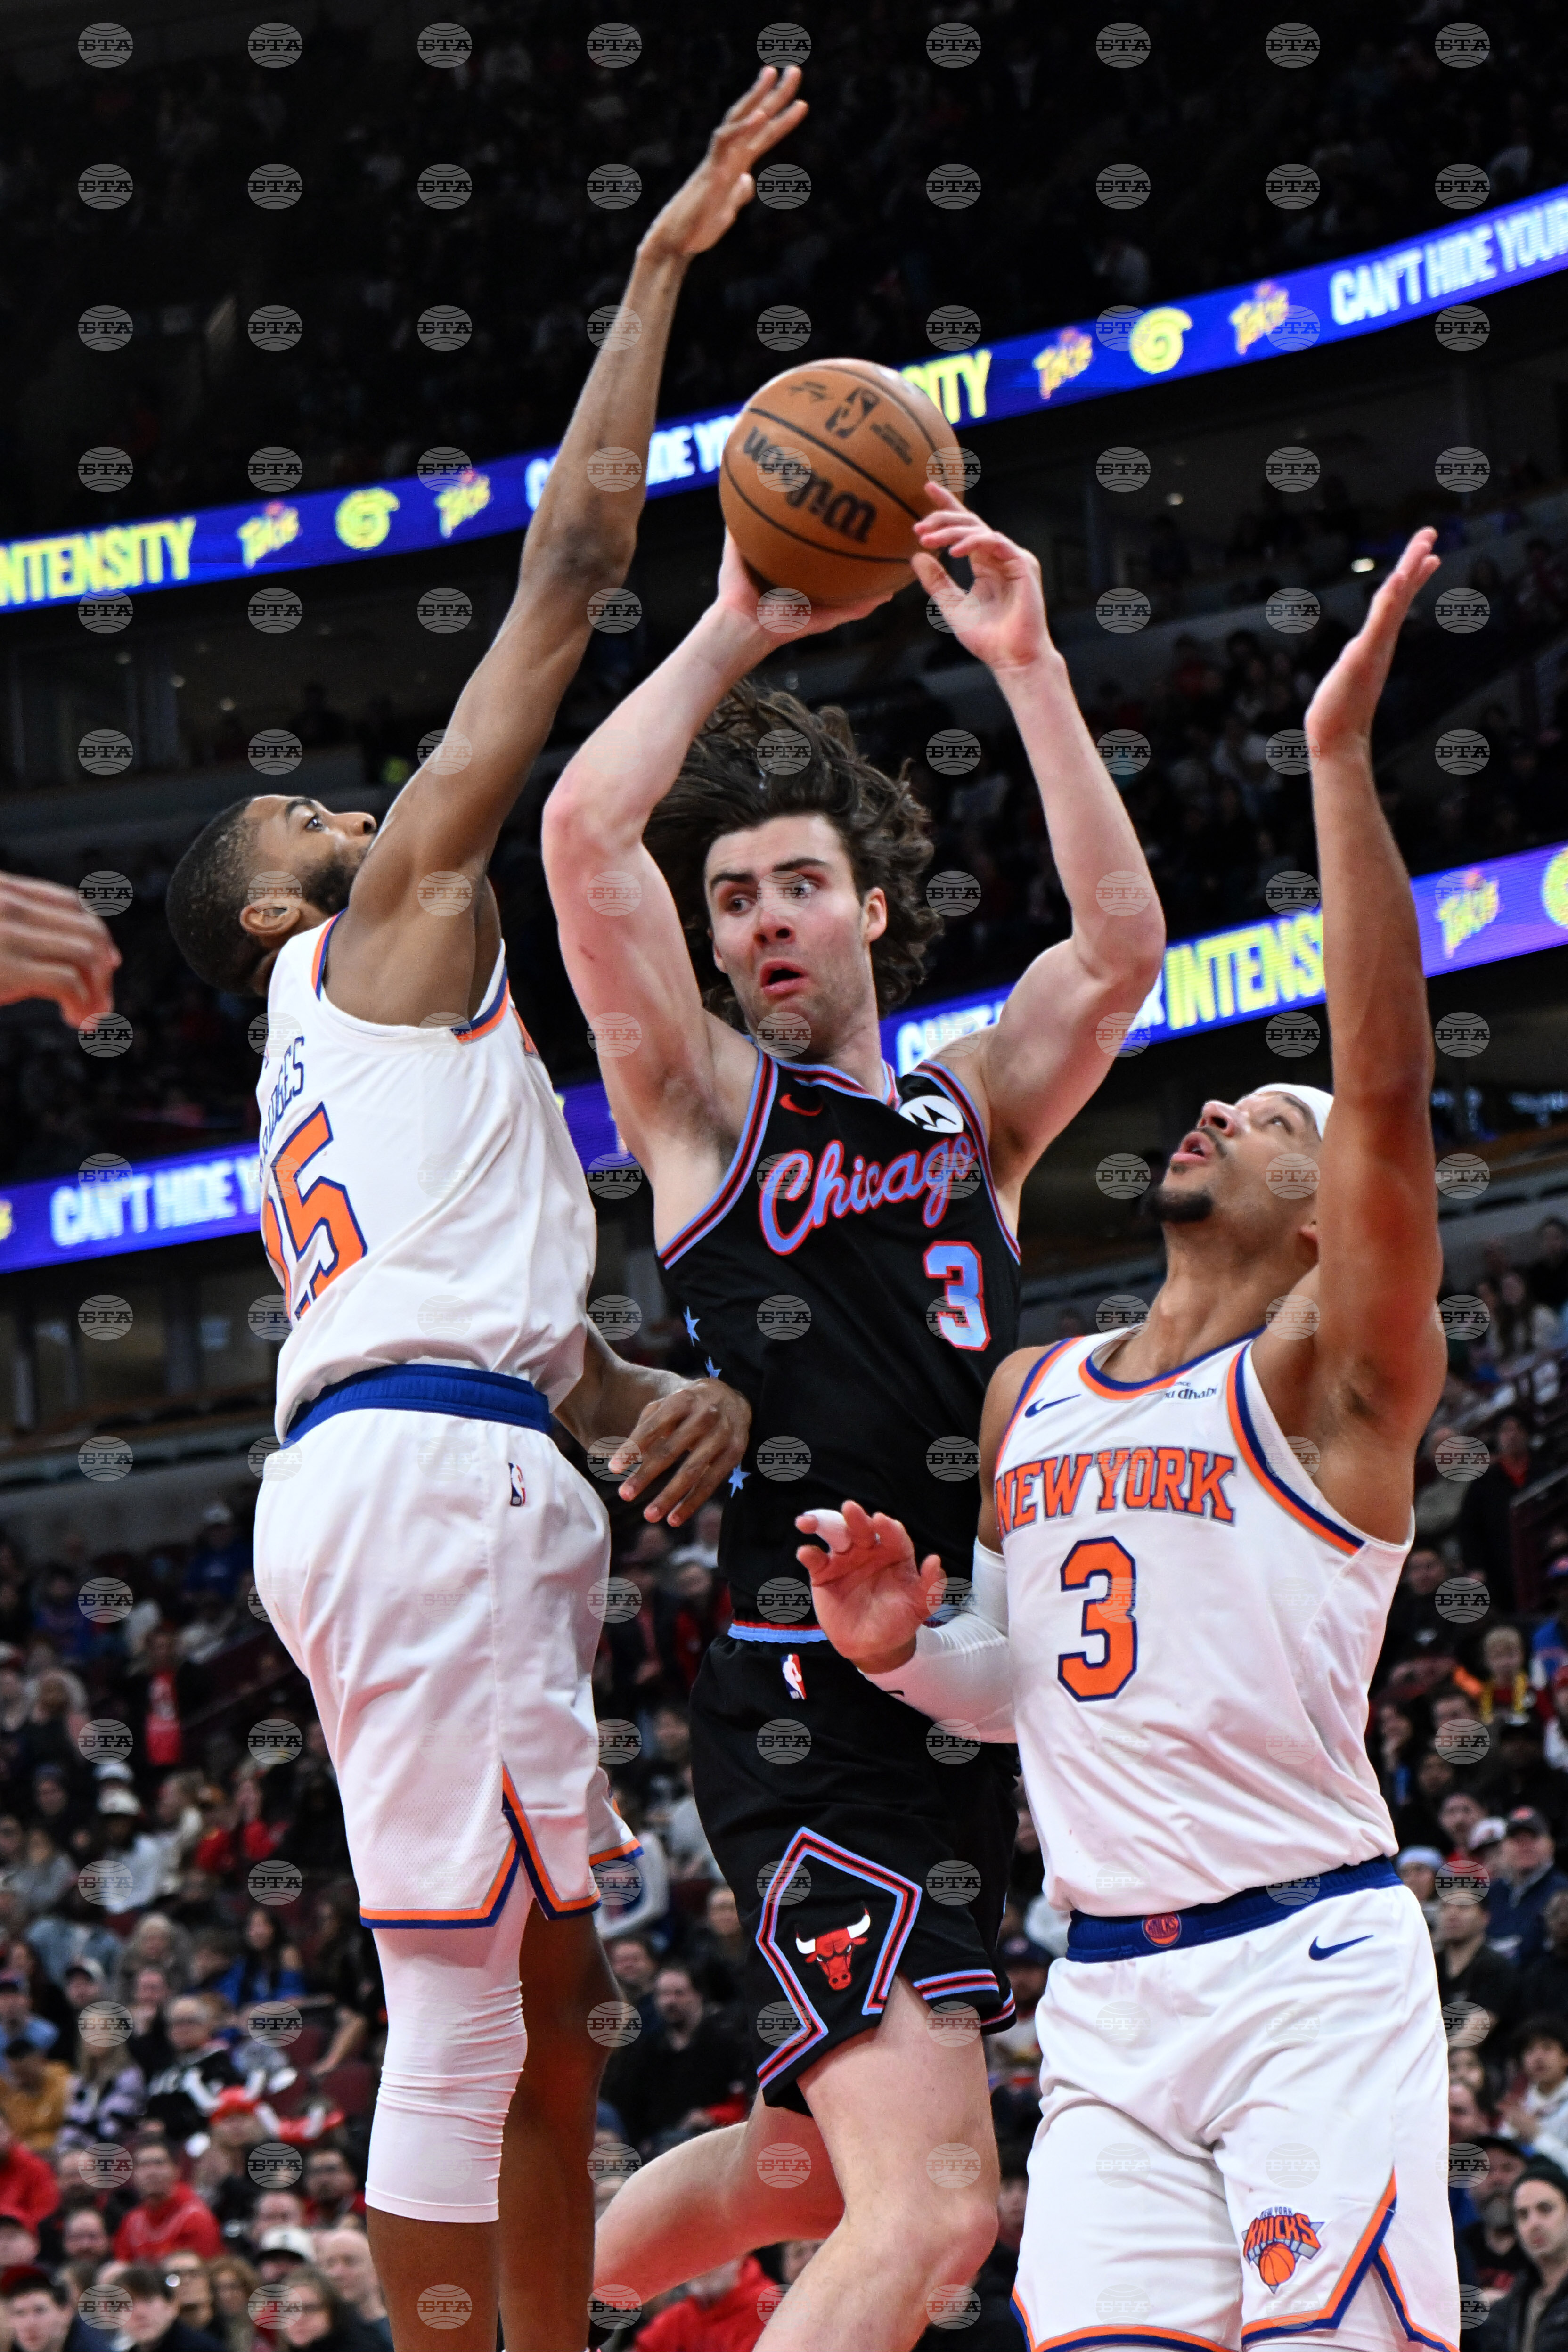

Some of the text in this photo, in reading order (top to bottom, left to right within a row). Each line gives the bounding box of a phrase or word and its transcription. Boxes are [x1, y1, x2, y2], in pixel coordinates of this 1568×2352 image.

[1425, 222, 1498, 299] HIDE
[743, 425, 877, 544] Wilson
[152, 1160, 236, 1229] HIDE
[758, 1133, 979, 1256] Chicago
[922, 1241, 991, 1352] 3
[994, 1446, 1237, 1540] NEW YORK
[1057, 1535, 1138, 1702] 3
[1243, 2212, 1321, 2257] KNICKS
